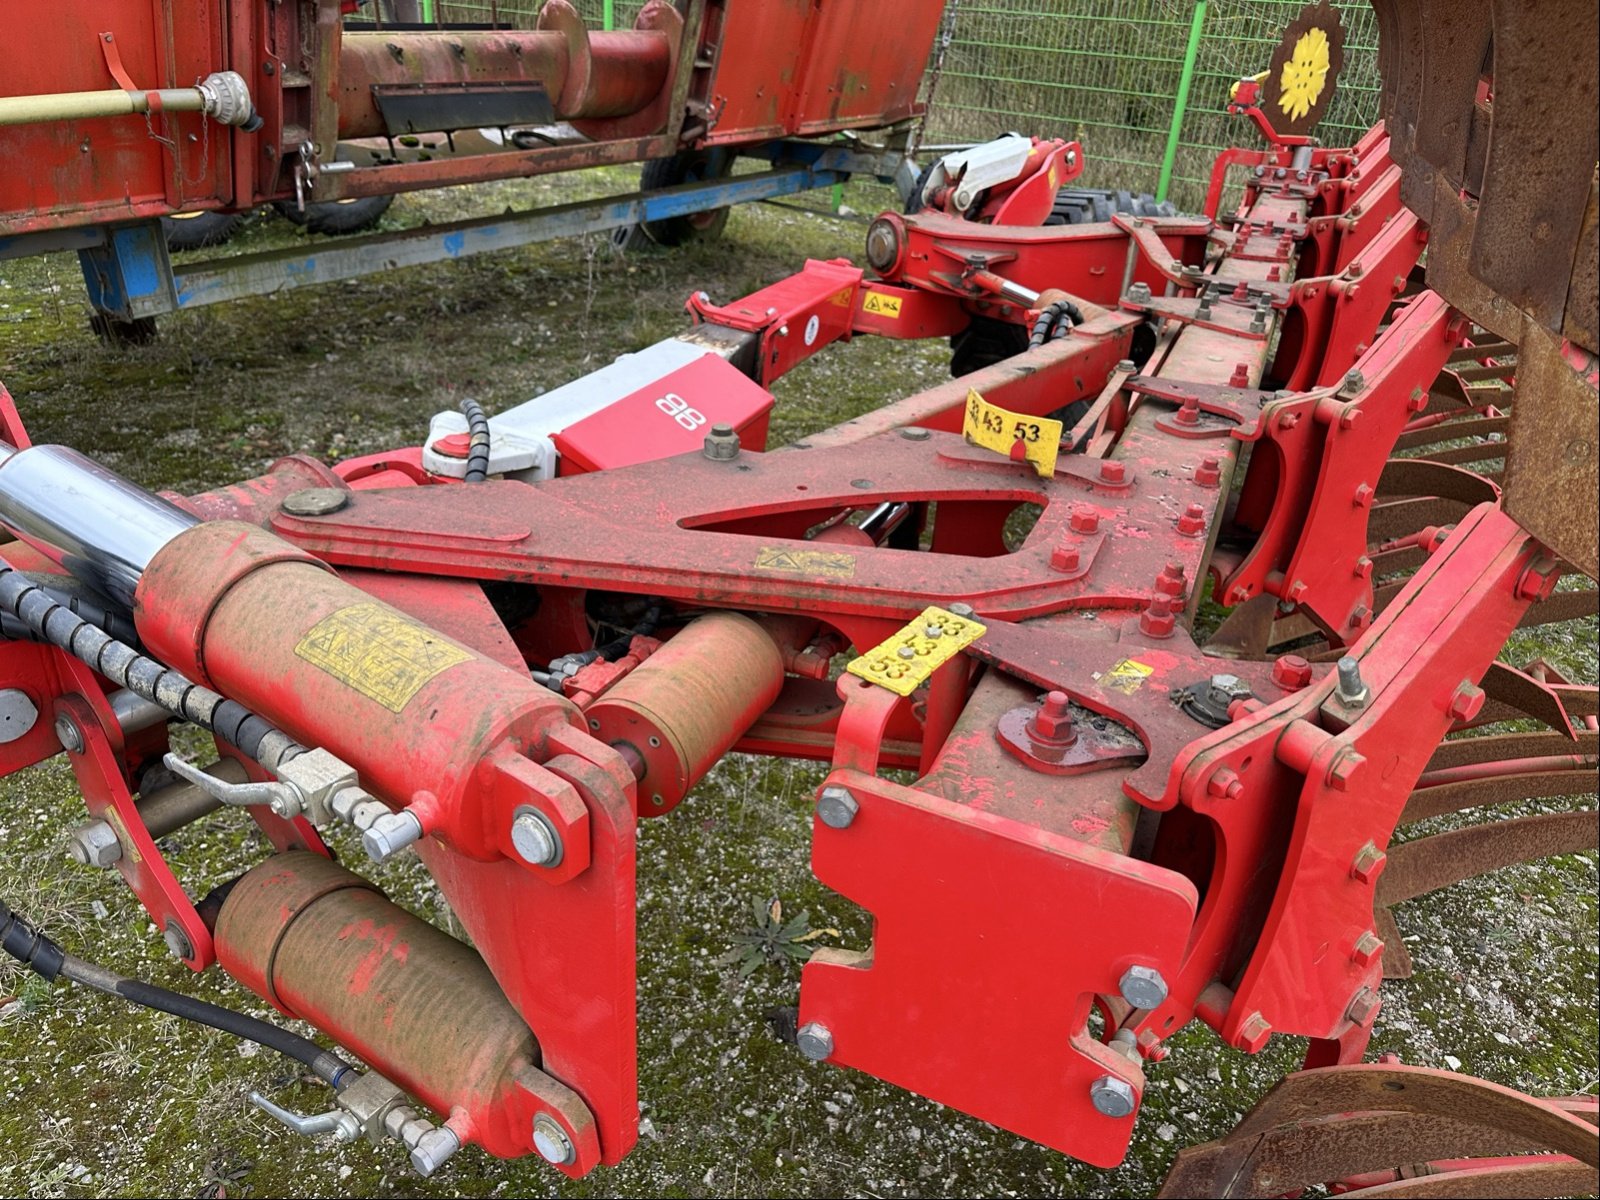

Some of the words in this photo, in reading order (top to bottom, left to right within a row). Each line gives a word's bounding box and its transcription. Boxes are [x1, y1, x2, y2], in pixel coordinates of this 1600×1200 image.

[983, 410, 1003, 434] 43
[1013, 421, 1040, 442] 53
[926, 615, 966, 636] 33
[869, 655, 911, 679] 53
